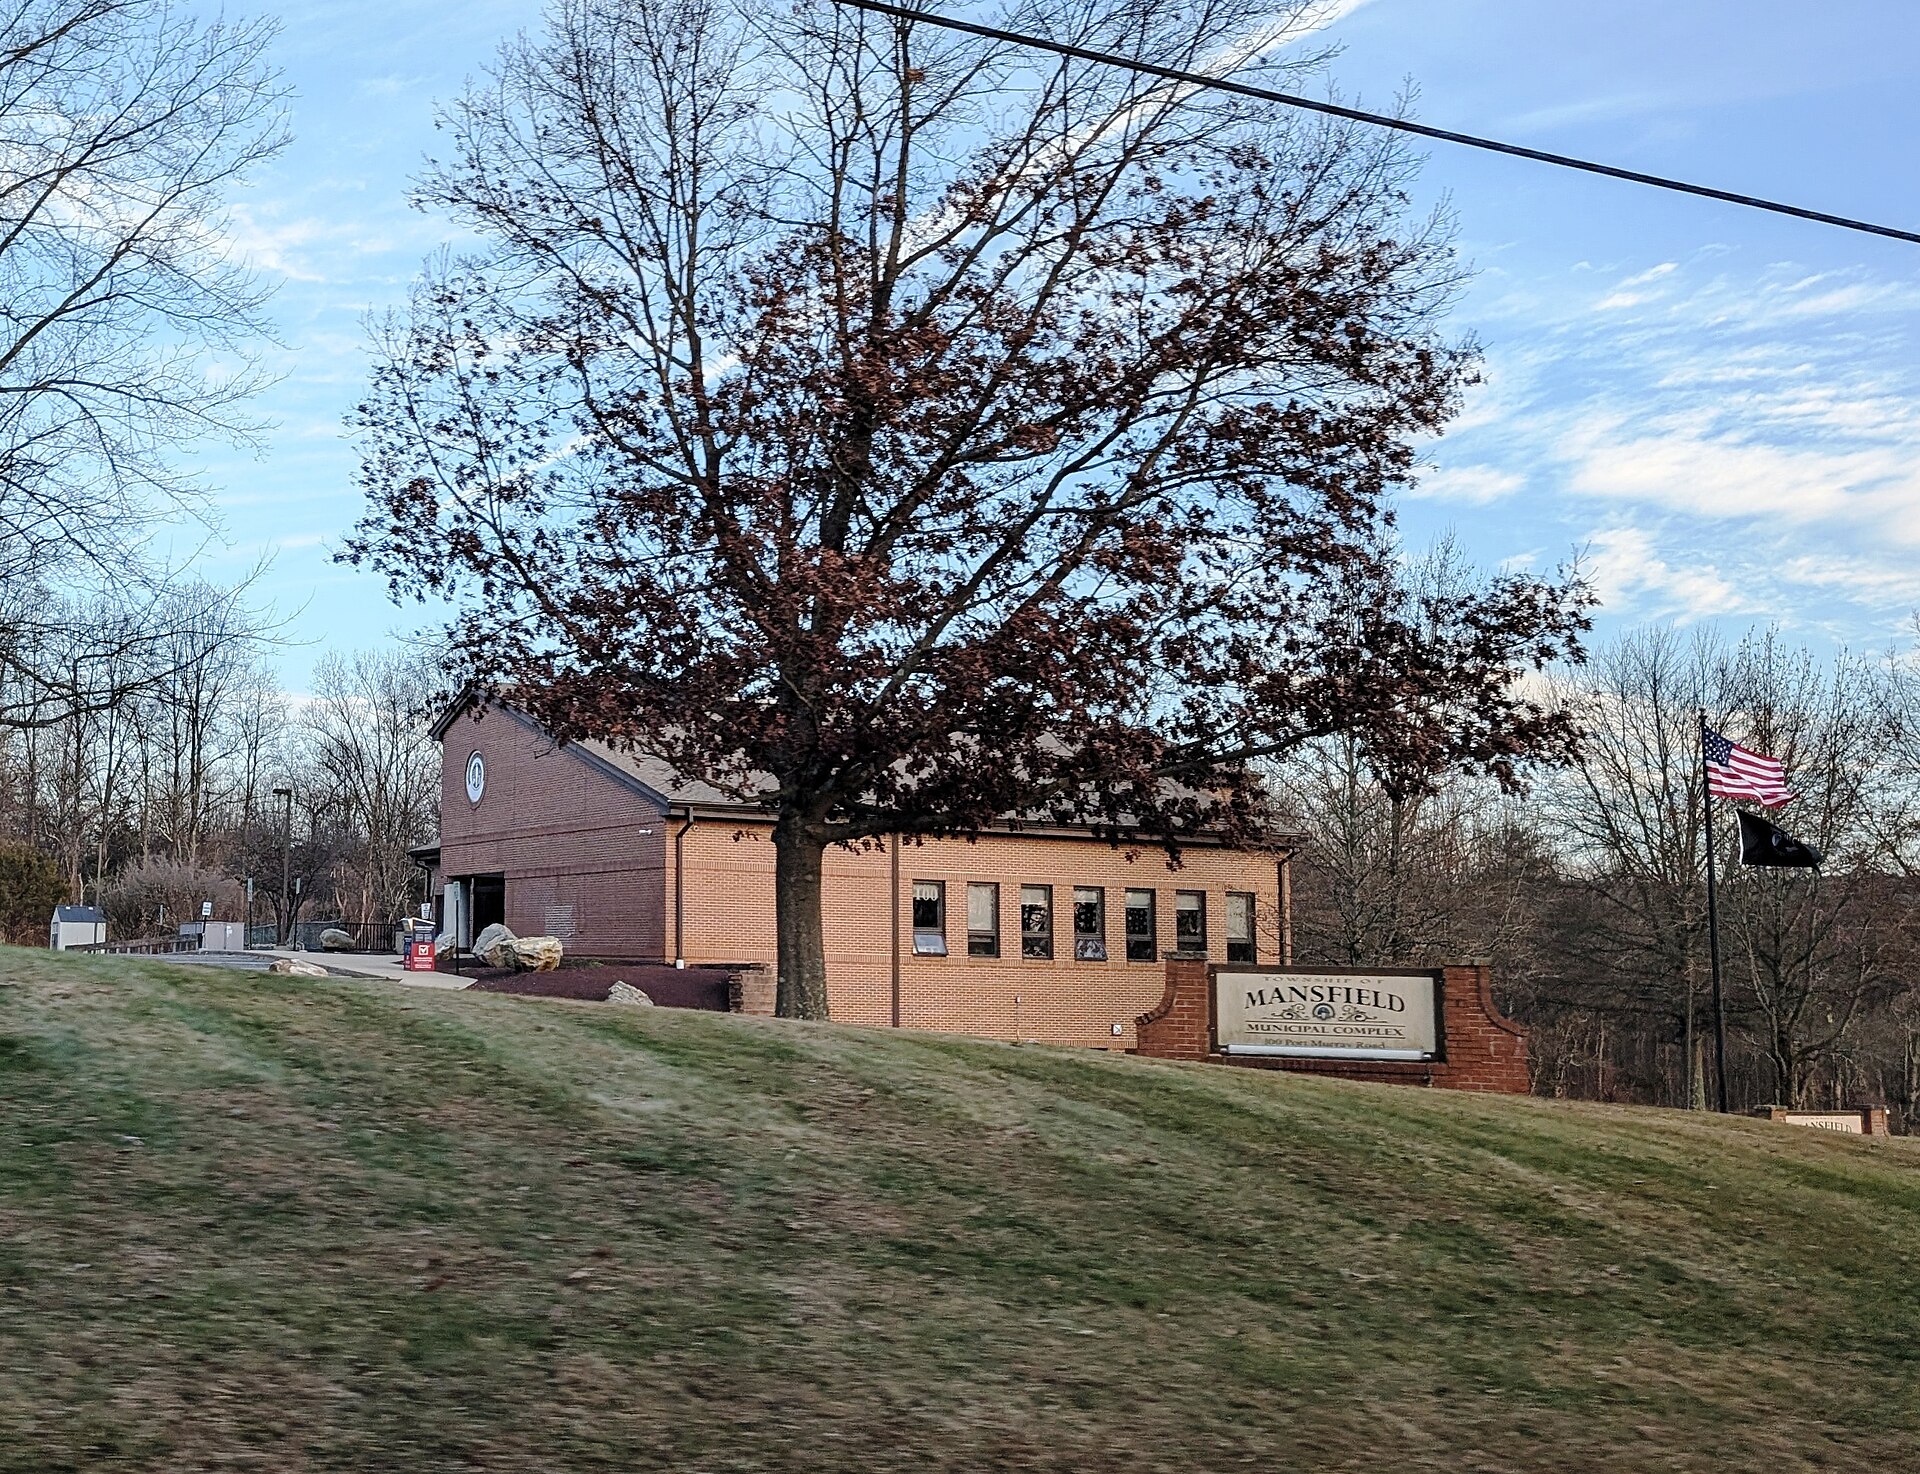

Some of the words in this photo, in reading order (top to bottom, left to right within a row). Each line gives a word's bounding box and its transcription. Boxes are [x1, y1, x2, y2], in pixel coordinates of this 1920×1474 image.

[916, 887, 939, 901] 100
[1245, 985, 1406, 1013] MANSFIELD
[1247, 1023, 1330, 1034] MUNICIPAL
[1333, 1026, 1404, 1037] COMPLEX
